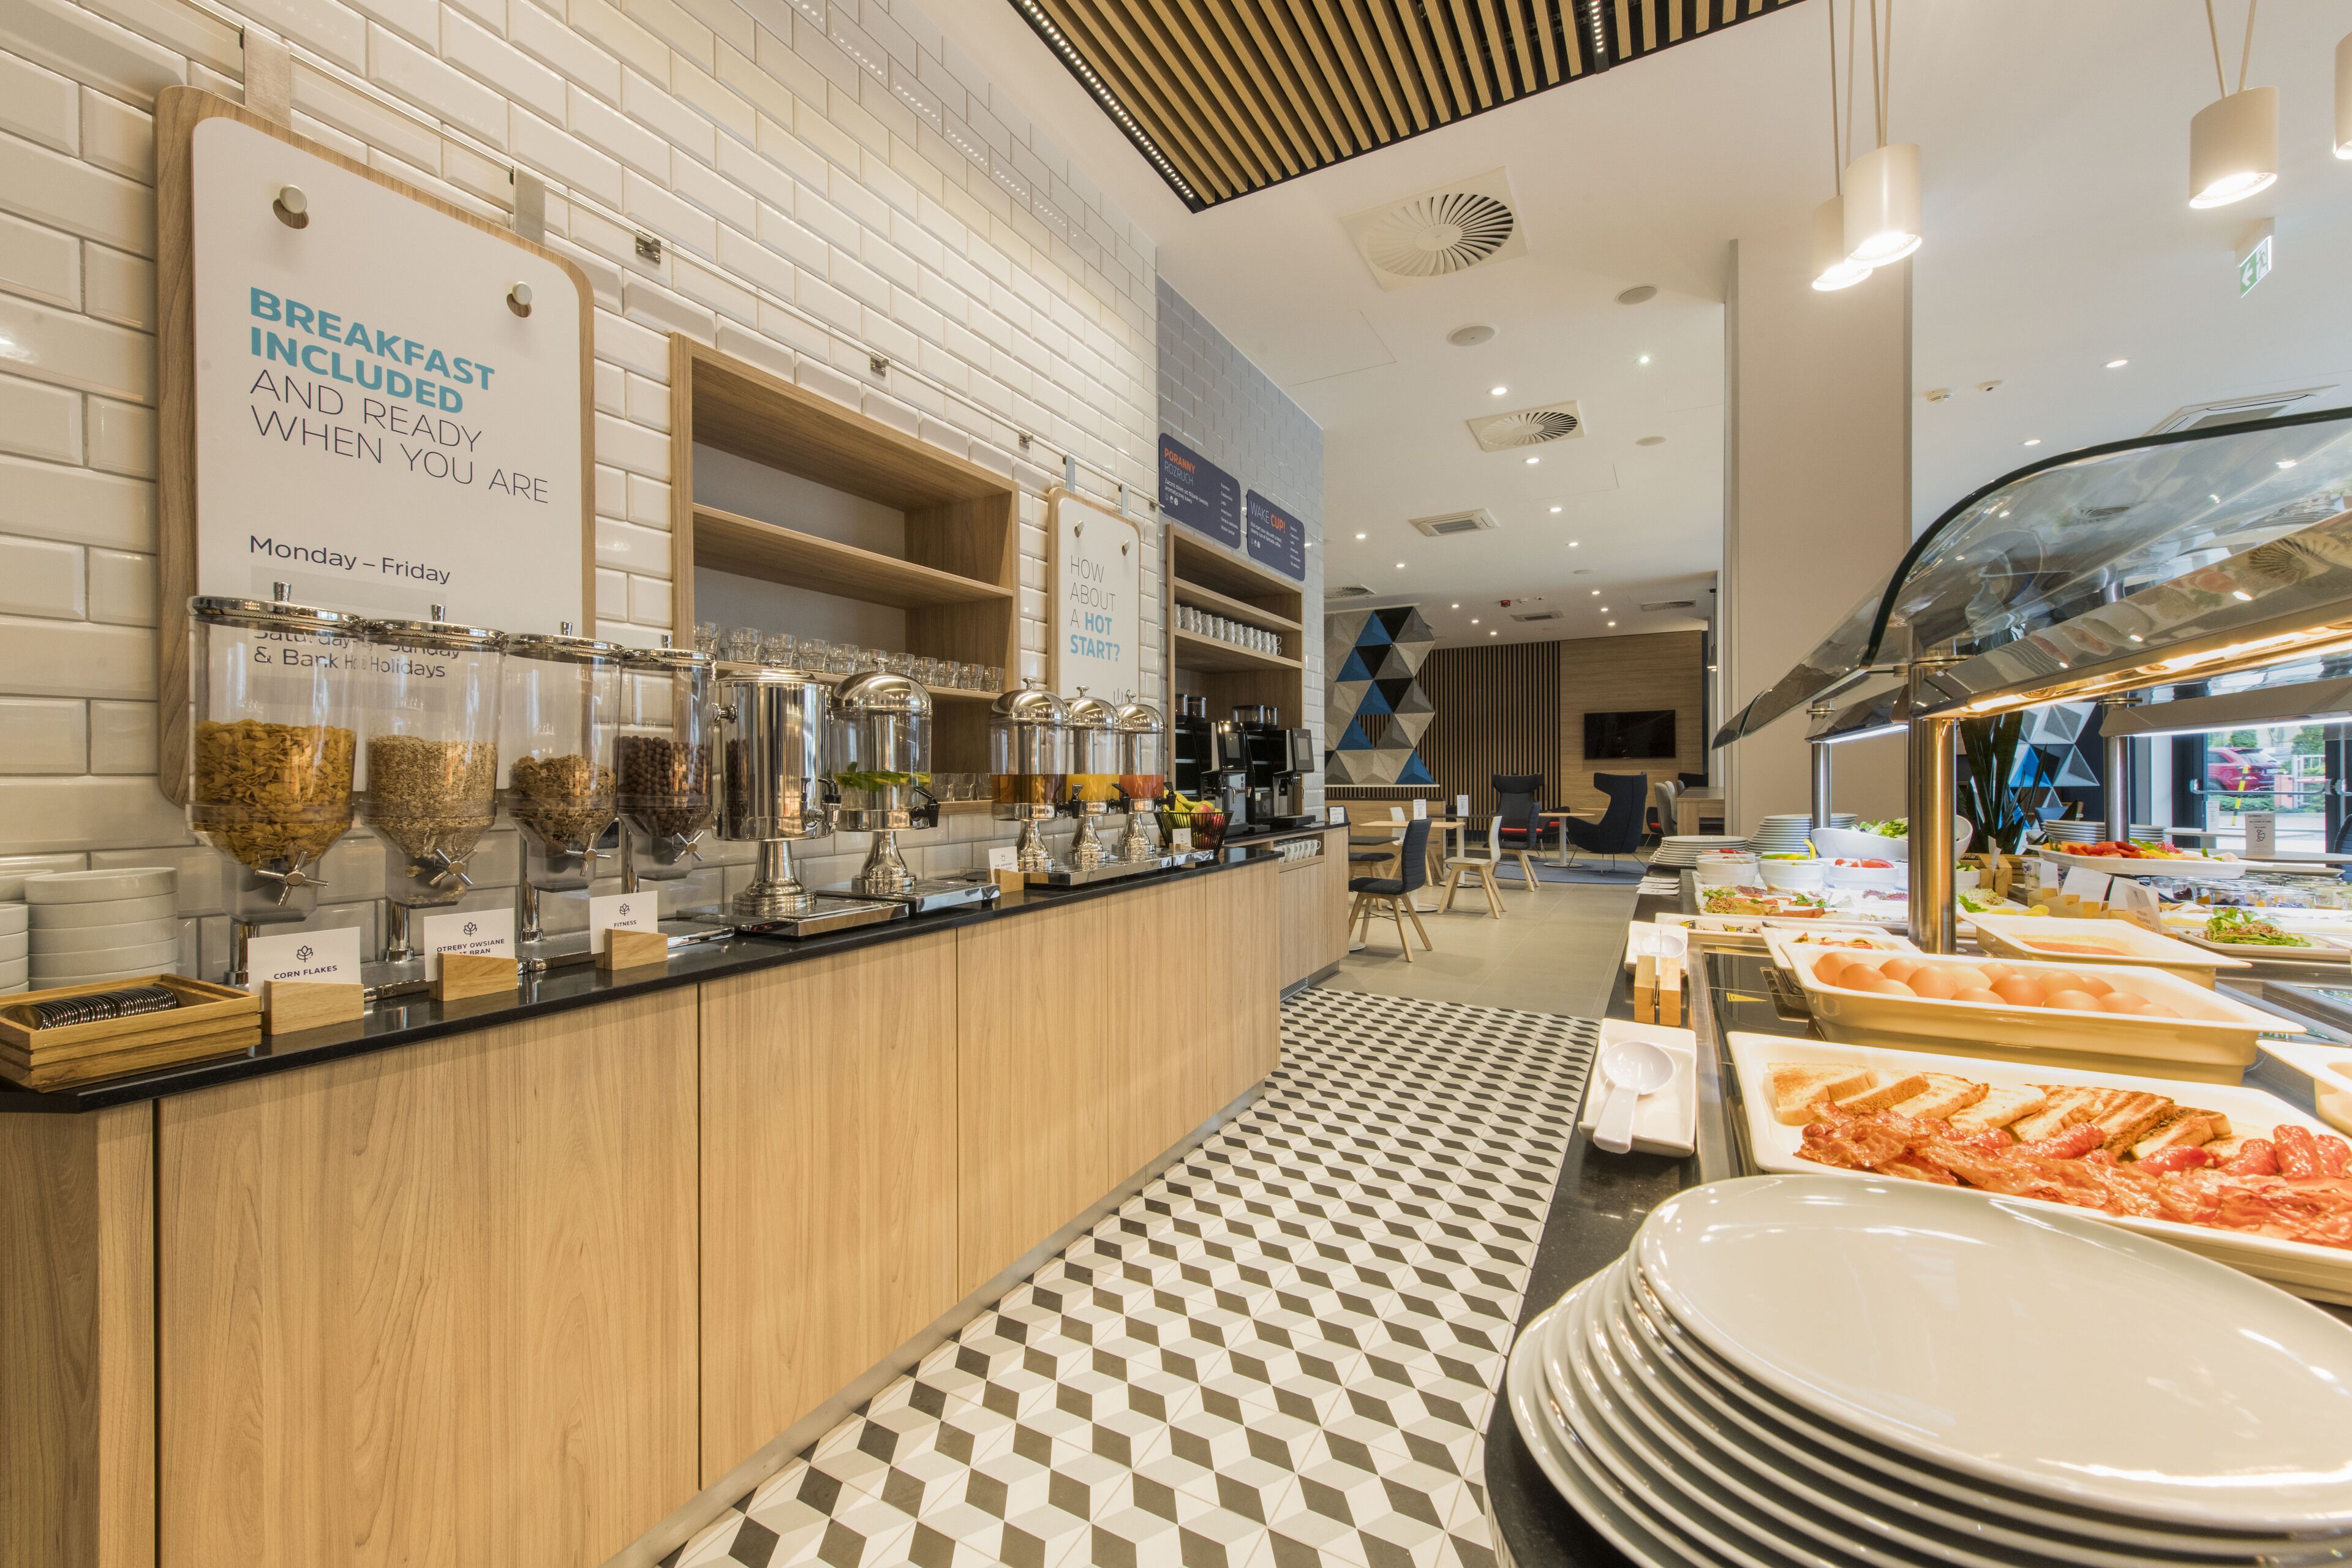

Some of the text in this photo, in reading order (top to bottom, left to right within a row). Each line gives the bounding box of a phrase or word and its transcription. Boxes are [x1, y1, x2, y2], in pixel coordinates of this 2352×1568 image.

[251, 287, 495, 391] BREAKFAST
[251, 326, 463, 413] INCLUDED
[250, 369, 481, 452] AND READY
[251, 405, 549, 503] WHEN YOU ARE
[1164, 448, 1196, 474] PORANNY
[1164, 461, 1194, 486] ROZRUCH
[1250, 500, 1286, 533] WAKE CUP!
[251, 535, 357, 571] Monday
[382, 557, 451, 585] Friday
[1070, 554, 1104, 583] HOW
[1070, 582, 1116, 611] ABOUT
[1070, 609, 1112, 635] A HOT
[254, 647, 272, 663] &
[283, 649, 338, 668] Bank
[1070, 634, 1120, 662] START?
[437, 938, 505, 952] OTRĘBY OWSIANE
[274, 965, 337, 979] CORN FLAKES
